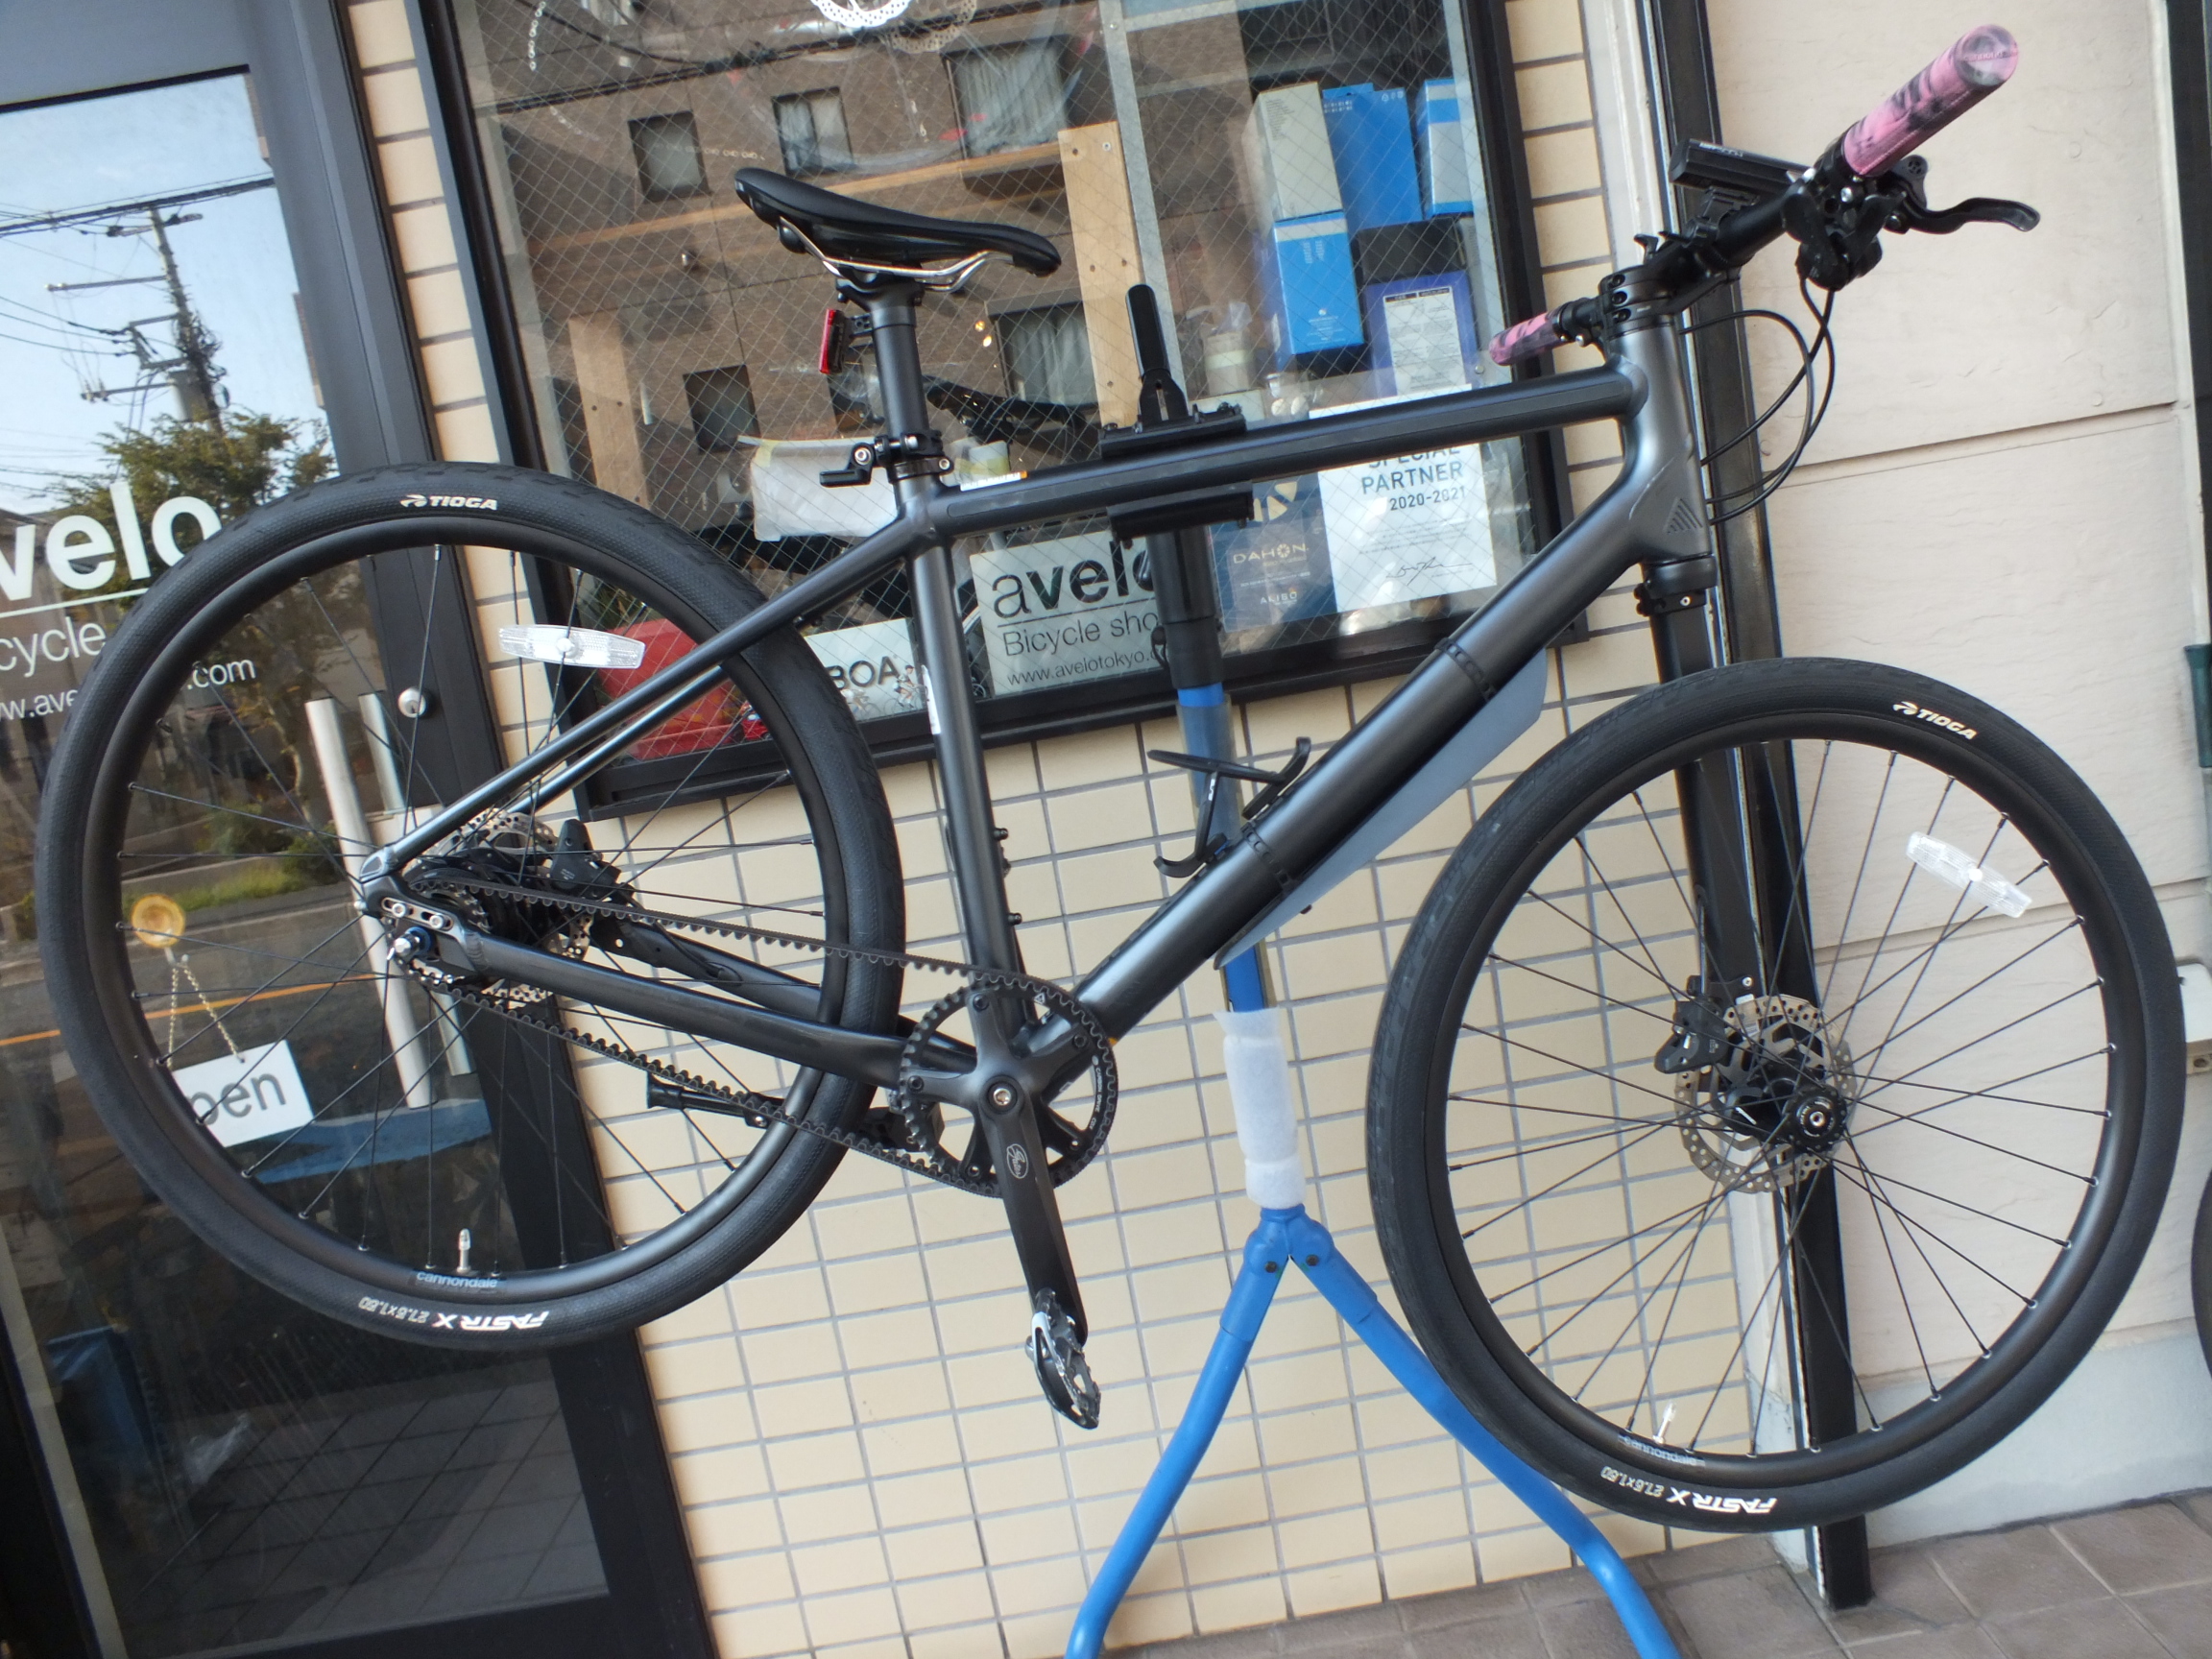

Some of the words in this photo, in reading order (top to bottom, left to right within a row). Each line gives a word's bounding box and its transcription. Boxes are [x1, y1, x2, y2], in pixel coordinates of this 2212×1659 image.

[1360, 461, 1464, 494] PARTNER
[429, 494, 497, 511] TIOGA
[1389, 486, 1467, 511] 2020-2021
[1233, 543, 1308, 565] DAHON
[1002, 619, 1101, 657] Bicycle
[1916, 709, 1978, 740] TIOGA
[416, 1270, 499, 1288] cannondale
